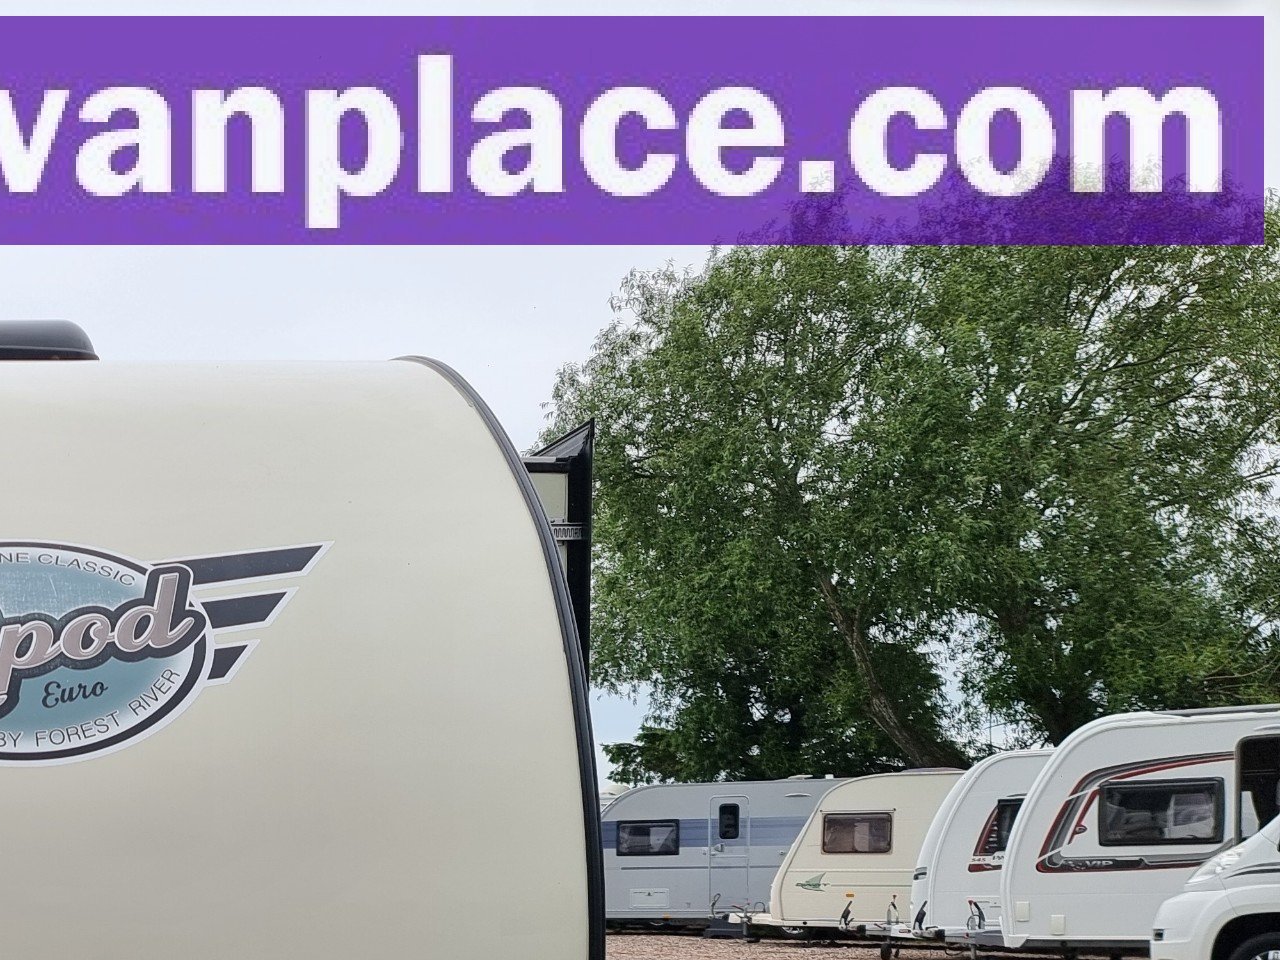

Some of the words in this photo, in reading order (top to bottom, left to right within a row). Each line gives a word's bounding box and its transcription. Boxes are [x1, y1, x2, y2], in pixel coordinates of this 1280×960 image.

[37, 551, 137, 587] CLASSIC
[34, 710, 121, 747] FOREST
[127, 667, 181, 717] RIVER
[41, 680, 109, 709] Euro
